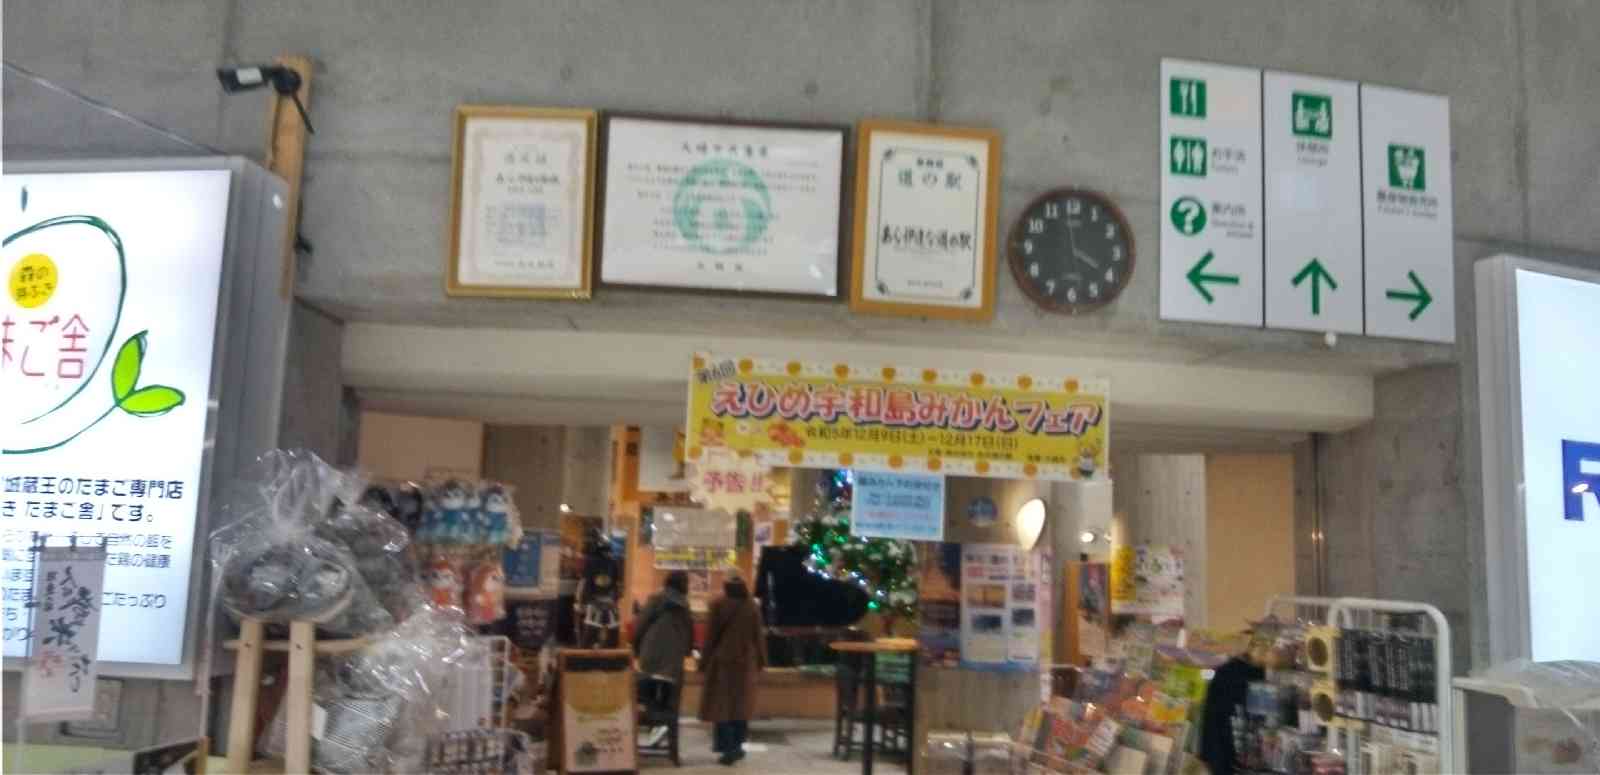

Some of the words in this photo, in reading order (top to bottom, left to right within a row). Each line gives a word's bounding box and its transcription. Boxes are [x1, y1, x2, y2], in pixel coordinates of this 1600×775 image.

[1044, 202, 1058, 219] 11
[1066, 200, 1081, 215] 12
[1090, 206, 1098, 222] 1
[1028, 219, 1044, 234] 10
[1105, 223, 1115, 239] 2
[1023, 239, 1033, 255] 9
[1112, 245, 1121, 262] 3
[1029, 262, 1039, 278] 8
[1104, 267, 1114, 283] 4
[1045, 280, 1056, 295] 7
[1066, 287, 1077, 303] 6
[1088, 281, 1098, 298] 5
[711, 381, 1102, 437] えひめ宇和島みかんフェア
